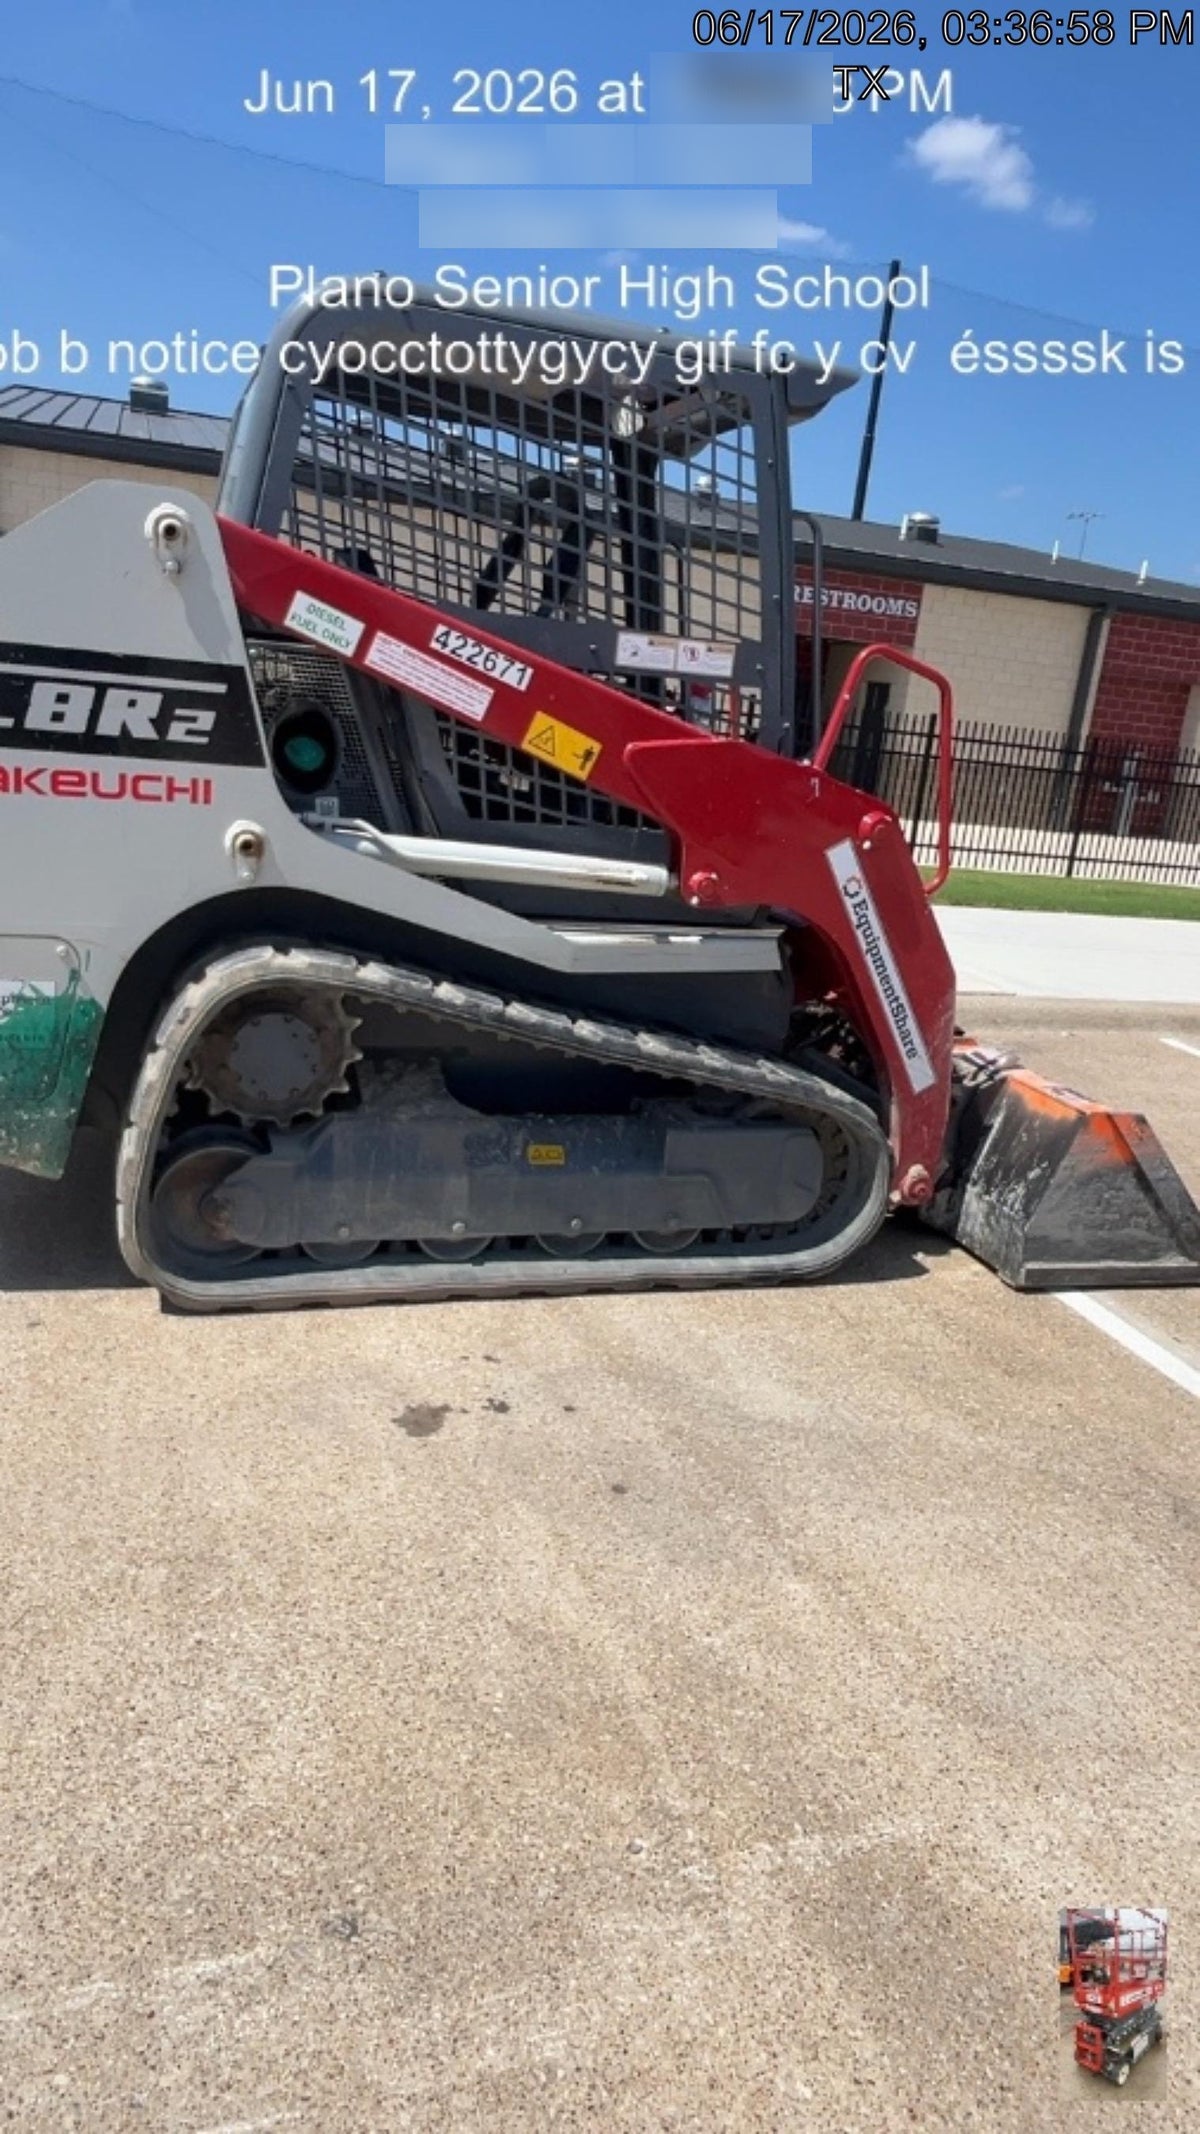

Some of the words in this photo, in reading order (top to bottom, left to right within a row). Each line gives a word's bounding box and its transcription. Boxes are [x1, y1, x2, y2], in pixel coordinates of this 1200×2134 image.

[306, 602, 346, 632] DIESEL
[436, 629, 527, 686] 422671
[852, 898, 919, 1061] EquipmentShare
